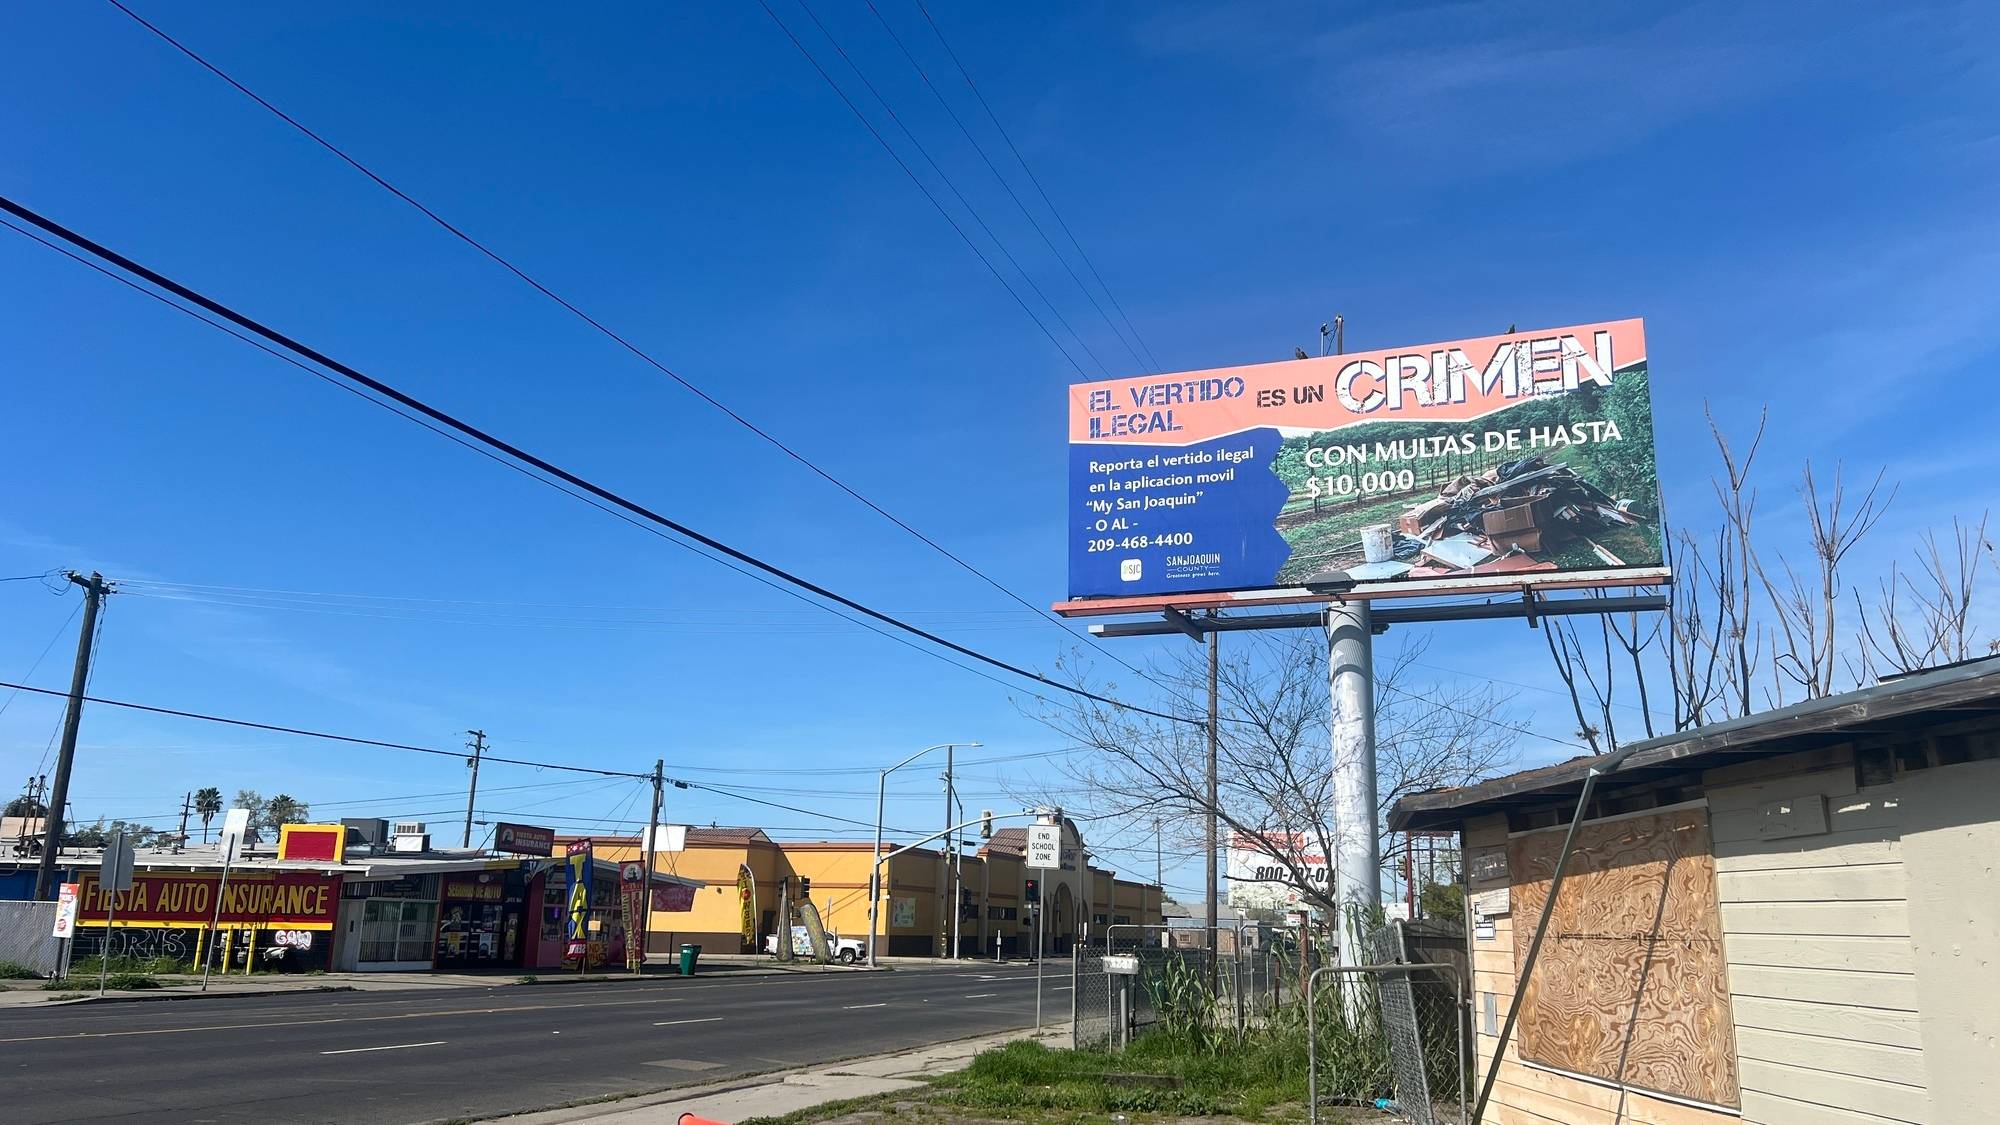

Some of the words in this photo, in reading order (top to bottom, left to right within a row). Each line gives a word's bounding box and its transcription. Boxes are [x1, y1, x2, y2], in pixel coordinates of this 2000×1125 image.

[1256, 388, 1287, 409] ES
[1293, 384, 1324, 405] UN
[1334, 330, 1614, 414] CRIMEN
[1089, 389, 1121, 413] EL
[1129, 376, 1246, 408] VERTIDO
[1089, 409, 1184, 439] ILEGAL
[1305, 442, 1367, 468] CON
[1375, 433, 1478, 462] MULTAS
[1484, 428, 1523, 453] DE
[1530, 420, 1623, 449] HASTA
[1089, 457, 1143, 475] Reporta
[1147, 455, 1159, 468] el
[1162, 450, 1213, 467] vertido
[1216, 445, 1255, 465] ilegal
[1089, 482, 1106, 493] en
[1109, 478, 1121, 491] la
[1124, 473, 1193, 493] aplicacion
[1196, 467, 1234, 483] movil
[1305, 468, 1415, 500] $10,000
[1116, 497, 1141, 511] San
[1095, 519, 1108, 532] O
[1111, 517, 1129, 531] AL
[1087, 532, 1194, 553] 209-468-4400
[1166, 555, 1183, 567] SAN
[1185, 553, 1220, 565] JOAQUIN
[1176, 565, 1209, 573] COUNTY
[515, 838, 551, 850] INSURANCE
[1031, 842, 1056, 851] SCHOOL
[1037, 832, 1050, 840] END
[1035, 852, 1052, 861] ZONE
[155, 882, 209, 913] AUTO
[214, 883, 330, 915] NSURANCE
